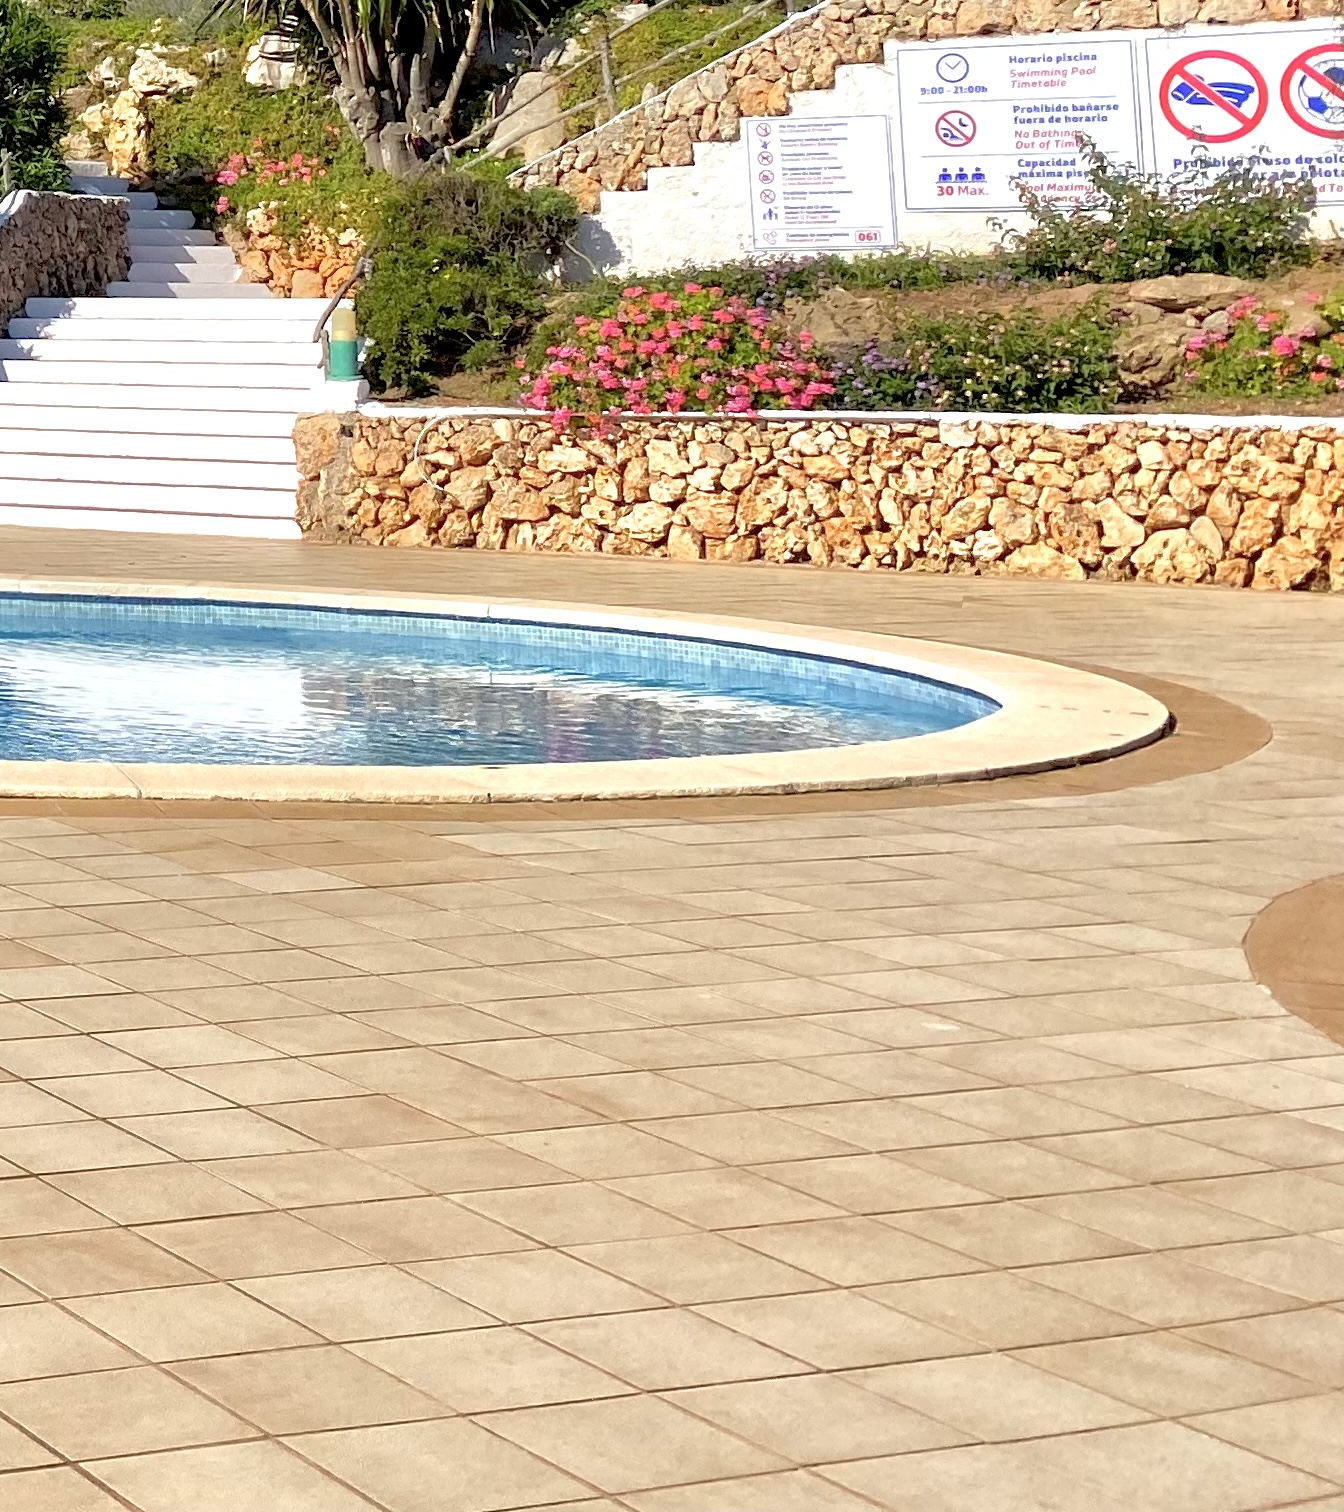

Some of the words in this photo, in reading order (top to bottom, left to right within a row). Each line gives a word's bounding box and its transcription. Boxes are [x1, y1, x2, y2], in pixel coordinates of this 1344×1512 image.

[1009, 55, 1053, 64] Horario
[1056, 52, 1098, 65] piscina
[1010, 68, 1068, 79] Swimming
[1071, 66, 1097, 76] Pool
[1011, 79, 1067, 88] Timetable
[920, 87, 945, 96] 9:00
[1013, 104, 1069, 114] Prohibido
[1072, 102, 1120, 112] bañarse
[1014, 116, 1045, 125] fuera
[1048, 115, 1062, 124] de
[1065, 114, 1108, 123] horario
[1015, 130, 1029, 139] No
[1016, 141, 1037, 150] Out
[1039, 140, 1050, 150] of
[1018, 158, 1076, 170] Capacidad
[1018, 169, 1063, 179] máxima
[937, 185, 955, 197] 30
[958, 185, 990, 197] Max.
[1020, 183, 1044, 192] ool
[858, 232, 878, 242] 061
